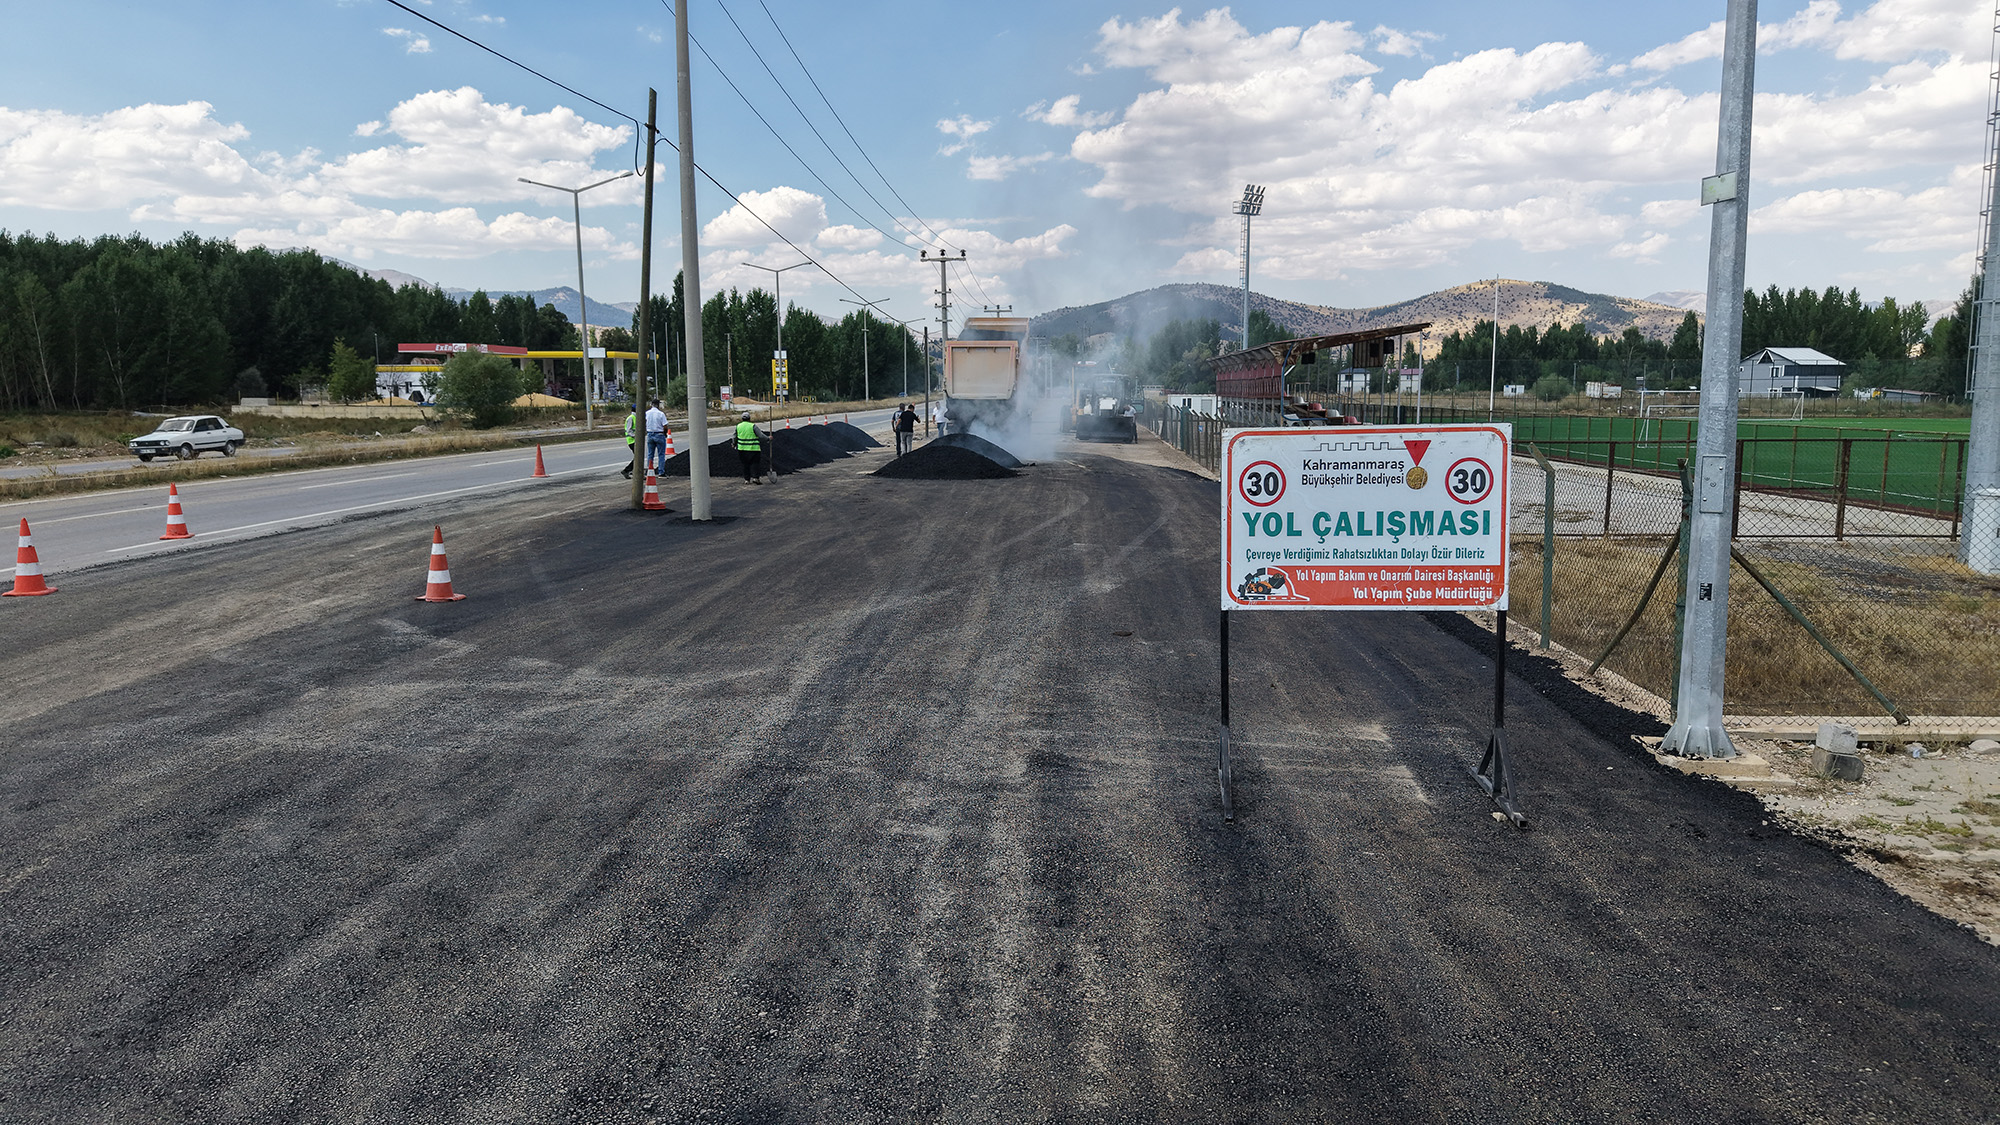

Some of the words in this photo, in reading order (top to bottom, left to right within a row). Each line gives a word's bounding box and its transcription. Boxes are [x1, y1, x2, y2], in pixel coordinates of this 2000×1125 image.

[1303, 459, 1405, 473] Kahramanmaraş
[1246, 471, 1279, 497] 30
[1302, 474, 1354, 488] Büyükşehir
[1356, 473, 1404, 487] Belediyesi
[1452, 468, 1486, 494] 30
[1242, 511, 1302, 537] YOL
[1312, 510, 1490, 544] ÇALIŞMASI
[1246, 548, 1281, 562] Çevreye
[1283, 547, 1330, 562] Verdiğimiz
[1333, 548, 1398, 560] Rahatsızlıktan
[1401, 547, 1429, 562] Dolayı
[1431, 545, 1453, 559] Özür
[1455, 547, 1485, 559] Dileriz
[1296, 569, 1309, 581] Yol
[1311, 569, 1336, 584] Yapım
[1339, 569, 1365, 581] Bakım
[1368, 572, 1378, 581] ve
[1380, 569, 1412, 581] Onarım
[1414, 569, 1445, 581] Dairesi
[1447, 568, 1494, 584] Başkanlığı
[1352, 587, 1368, 599] Yol
[1370, 587, 1402, 602] Yapım
[1405, 587, 1432, 602] Şube
[1435, 586, 1493, 602] Müdürlüğü
